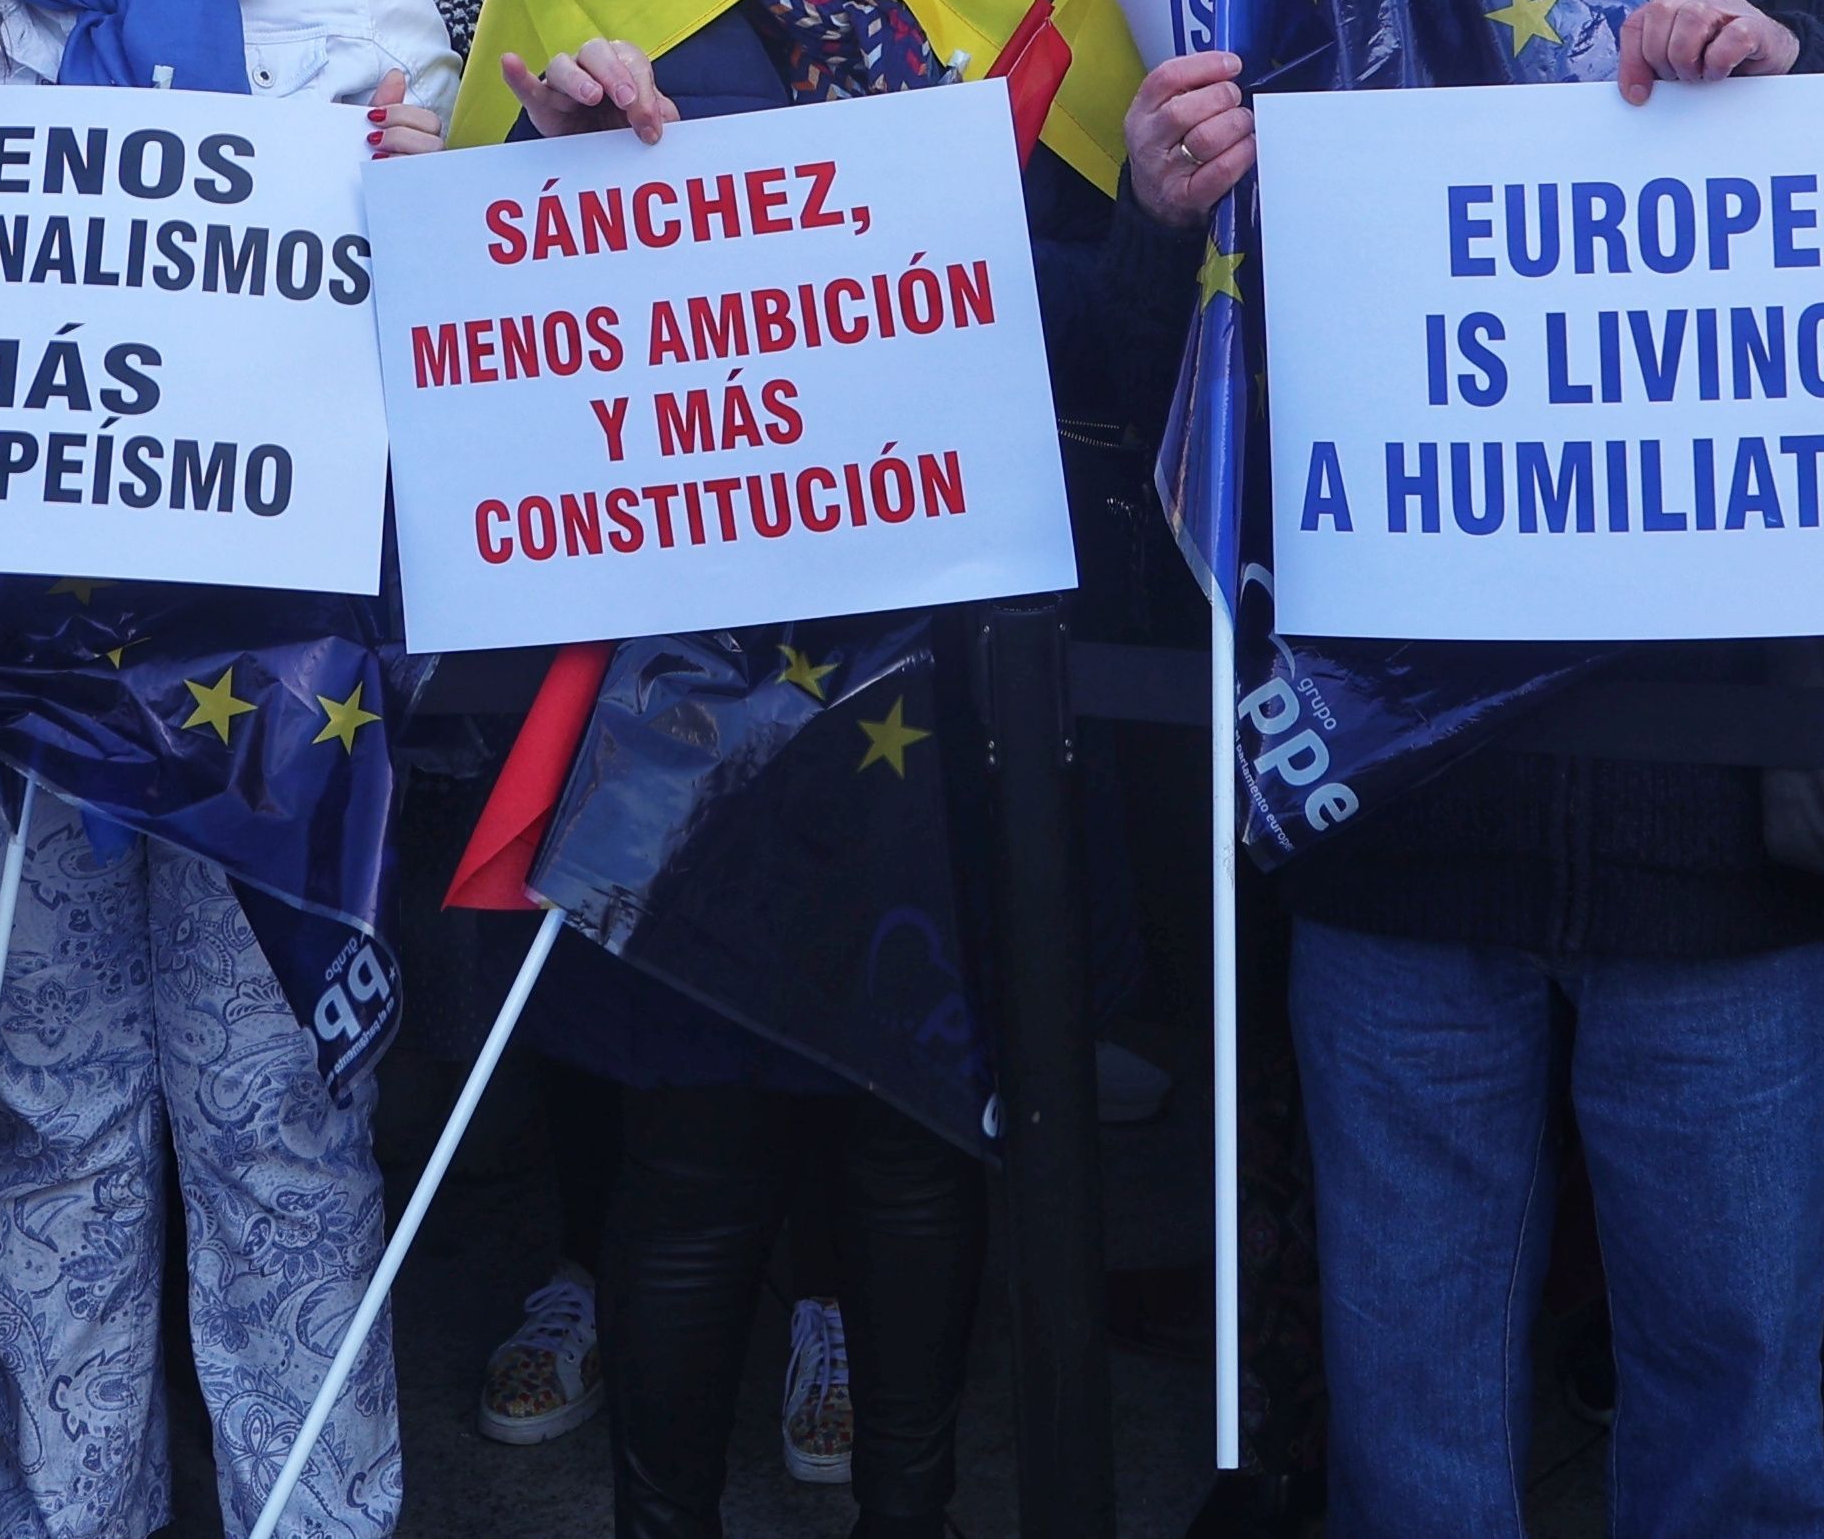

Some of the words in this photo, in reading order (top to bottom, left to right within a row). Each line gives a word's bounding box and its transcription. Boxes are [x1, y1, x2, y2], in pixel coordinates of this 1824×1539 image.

[486, 161, 871, 264] SÁNCHEZ,
[1447, 174, 1822, 278] EUROPE
[411, 305, 624, 389] MENOS
[648, 251, 996, 366] AMBICIÓN
[1426, 311, 1509, 407] IS
[589, 397, 629, 462] Y
[653, 368, 805, 456] MÁS
[475, 441, 967, 564] CONSTITUCIÓN
[1299, 441, 1354, 532] A
[1297, 677, 1337, 730] grupo
[1236, 744, 1269, 813] parlamento
